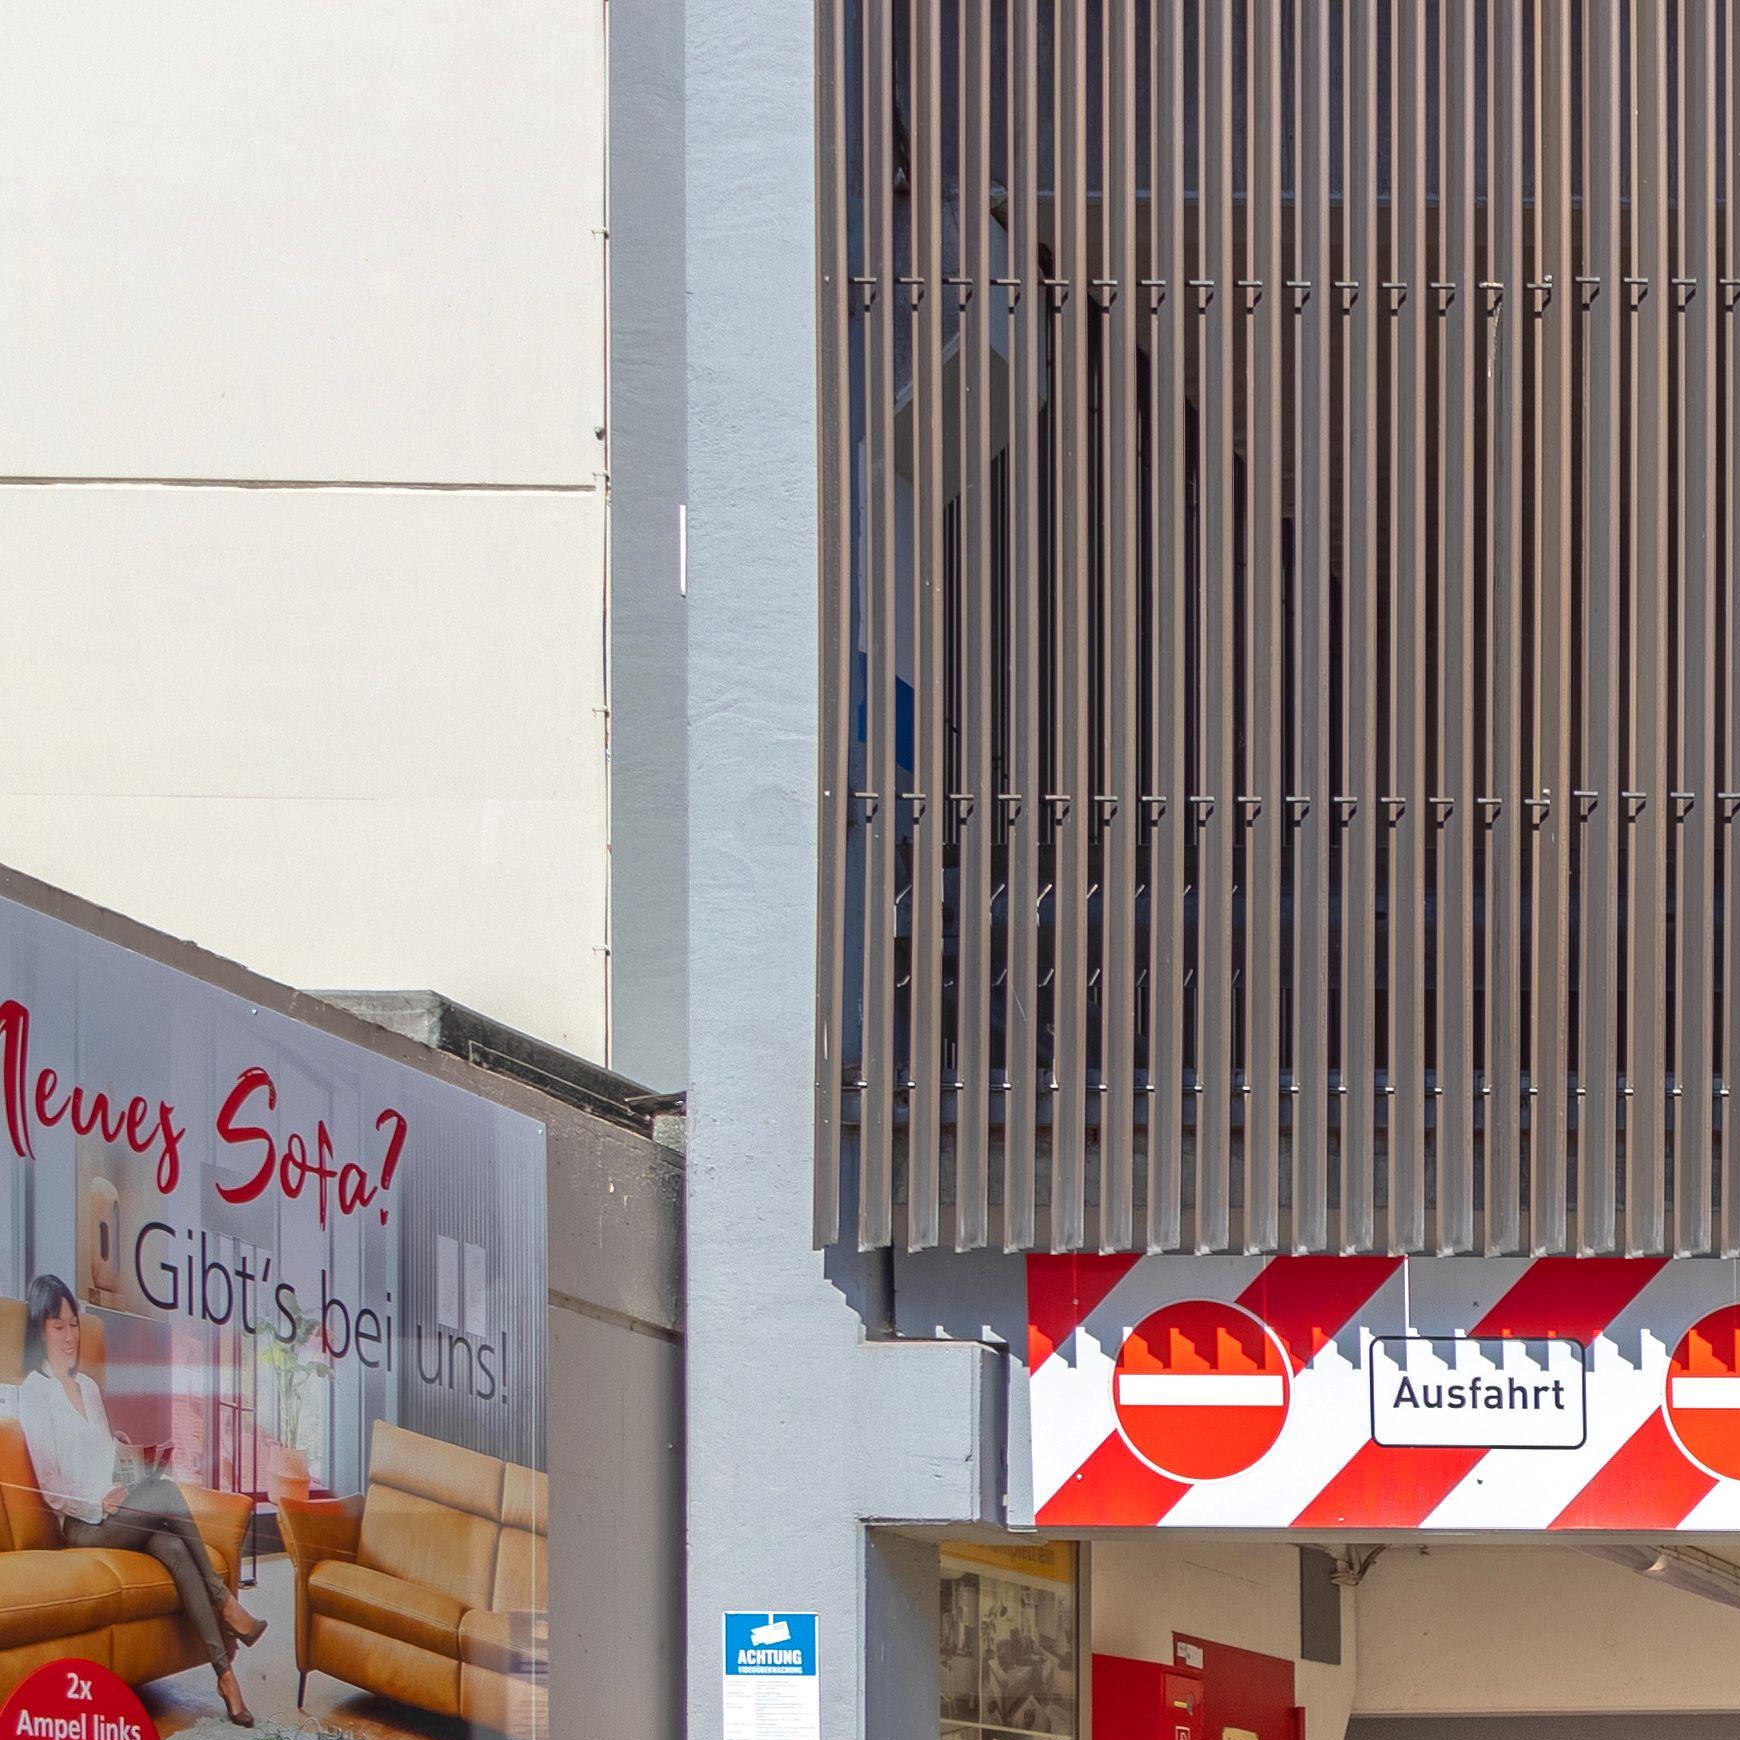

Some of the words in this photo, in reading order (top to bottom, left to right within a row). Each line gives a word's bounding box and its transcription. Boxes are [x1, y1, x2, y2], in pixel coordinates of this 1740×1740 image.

[215, 1066, 407, 1231] Sofa?
[321, 1269, 391, 1372] bei
[416, 1324, 508, 1404] uns!
[1394, 1376, 1565, 1411] Ausfahrt
[737, 1649, 802, 1665] ACHTUNG
[67, 1673, 92, 1700] 2x
